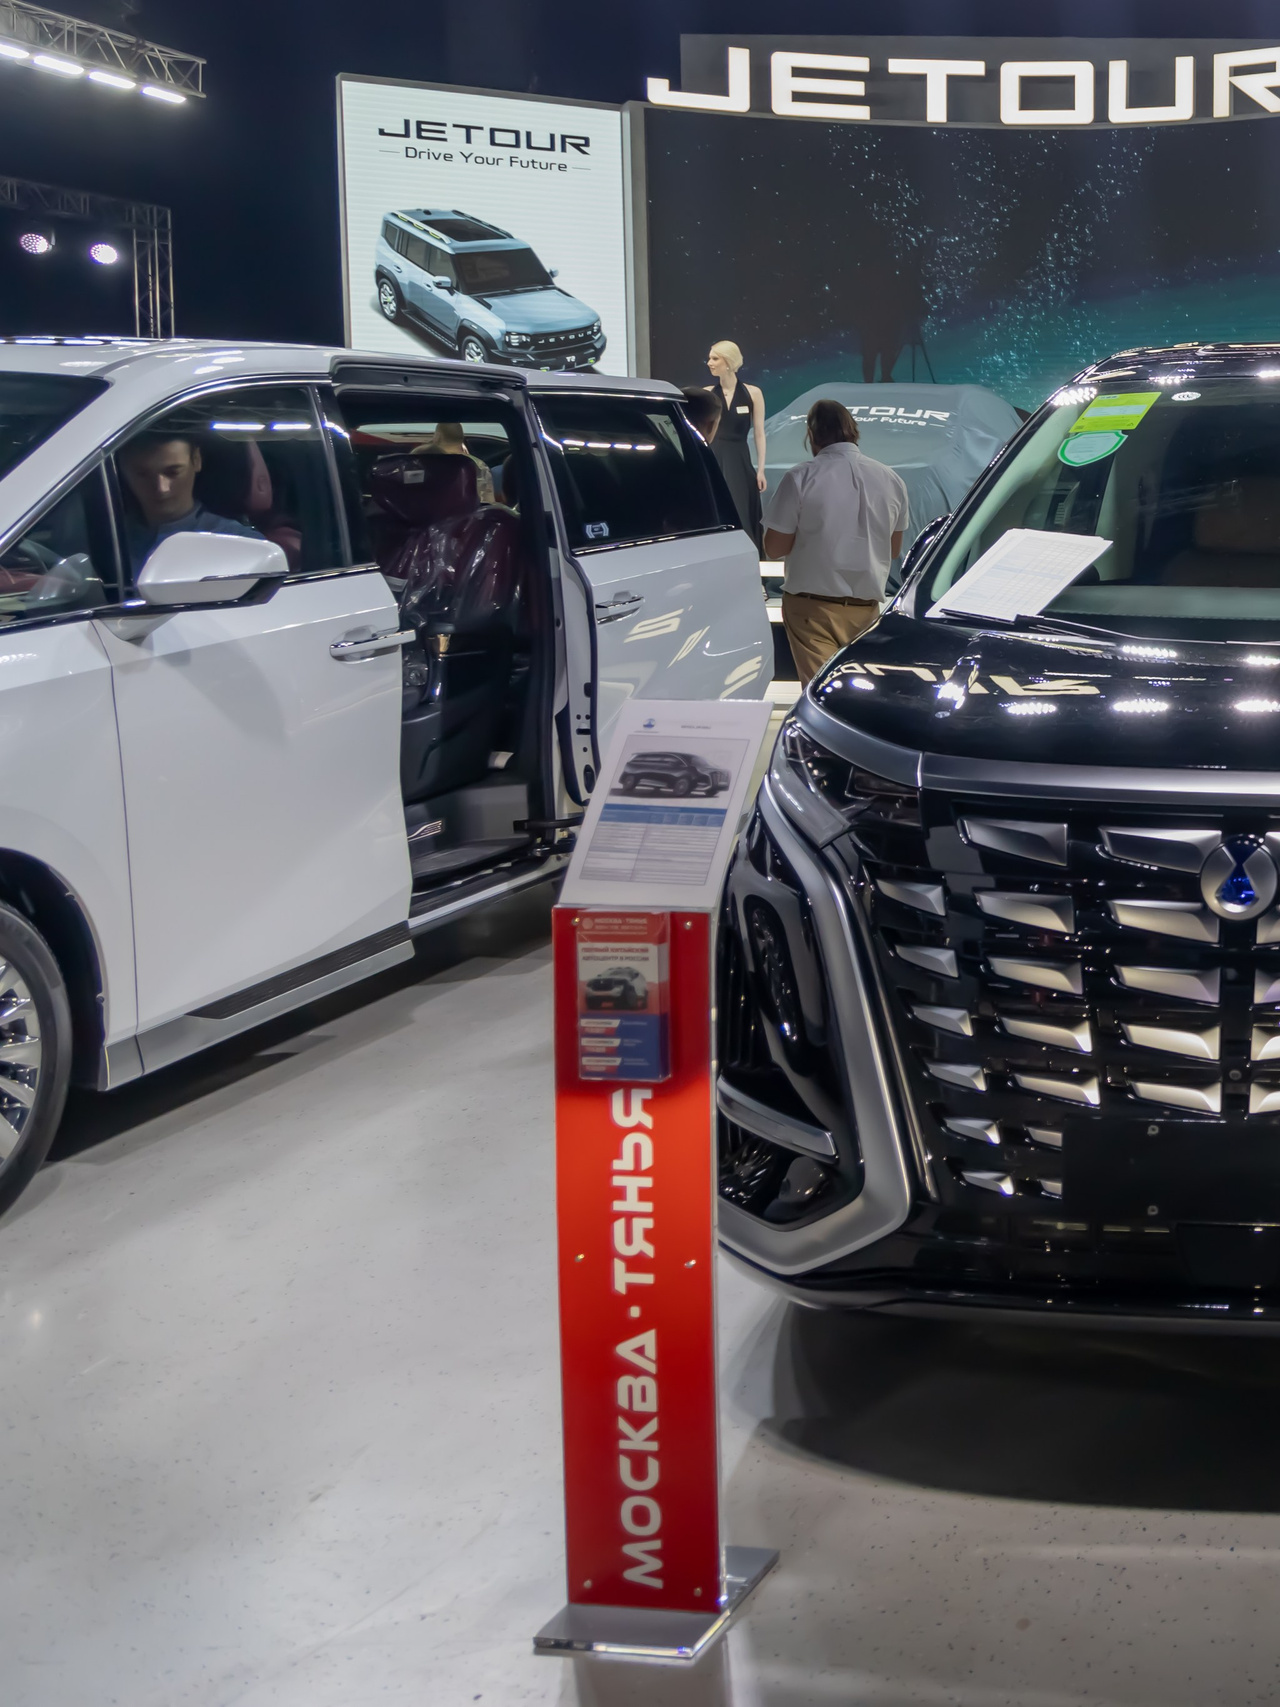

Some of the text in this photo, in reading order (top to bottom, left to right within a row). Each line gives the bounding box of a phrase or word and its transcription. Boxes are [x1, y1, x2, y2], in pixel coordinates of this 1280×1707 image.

[378, 118, 591, 155] JETOUR
[405, 146, 567, 172] Drive Your Future
[538, 331, 592, 344] JETOUR
[791, 406, 950, 421] TOUR
[880, 416, 927, 426] Future
[612, 1087, 656, 1294] ТЯНЬЯ
[615, 1329, 664, 1589] МОСКВА
